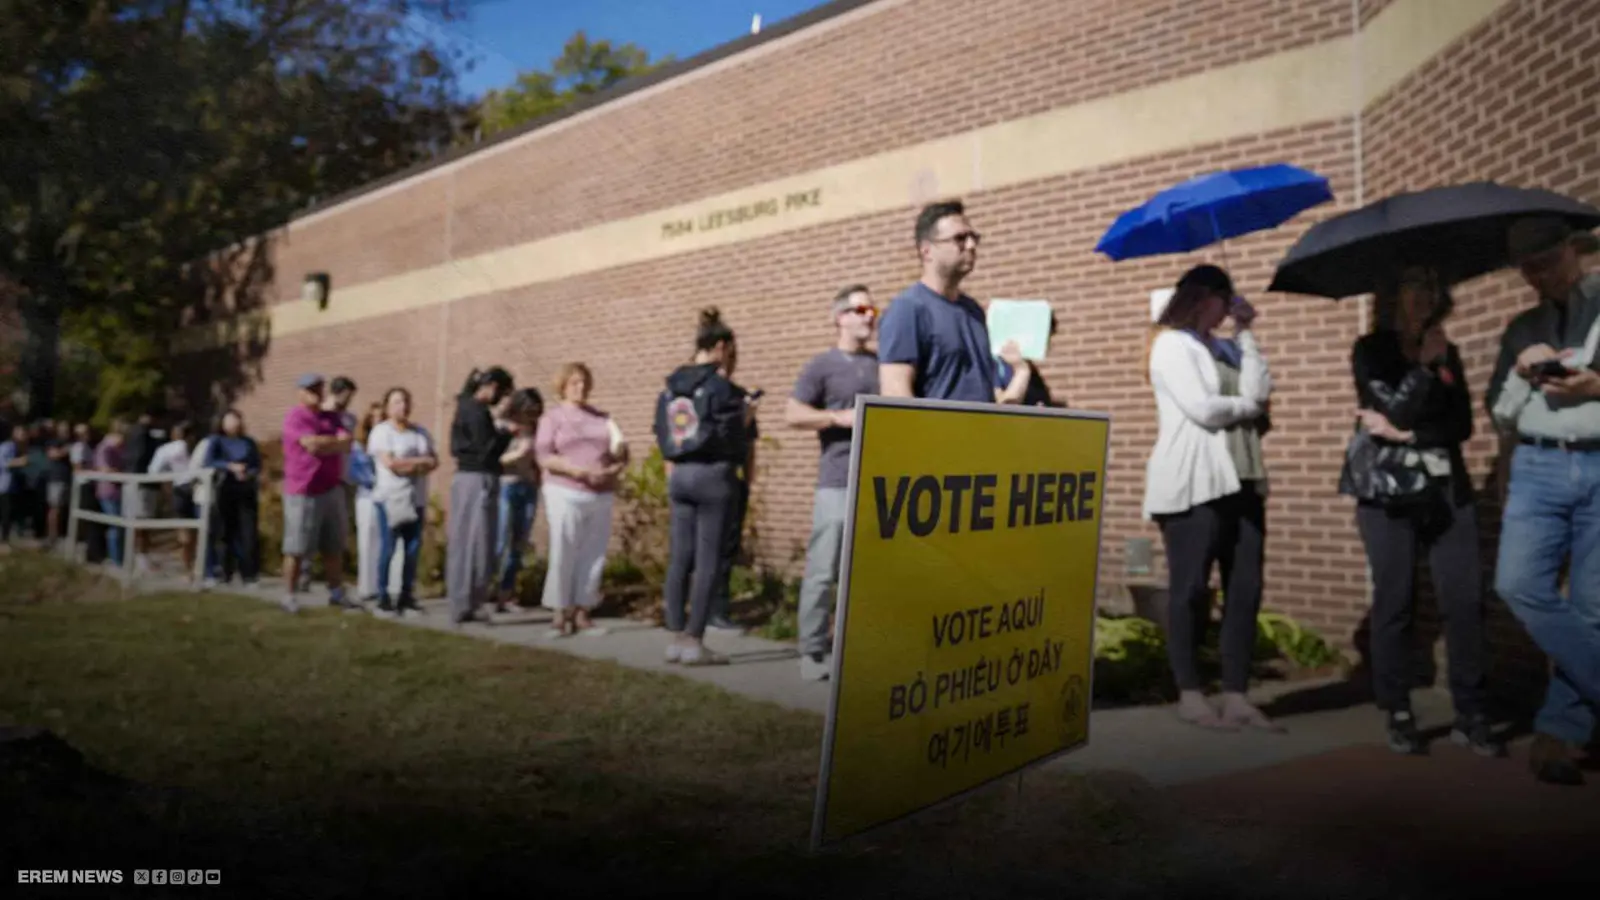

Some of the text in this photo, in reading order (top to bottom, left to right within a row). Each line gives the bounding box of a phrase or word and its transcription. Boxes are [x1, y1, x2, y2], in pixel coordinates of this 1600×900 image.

[873, 472, 1096, 539] VOTE HERE
[933, 588, 1044, 648] VOTE AQUÍ
[890, 671, 928, 721] BỎ
